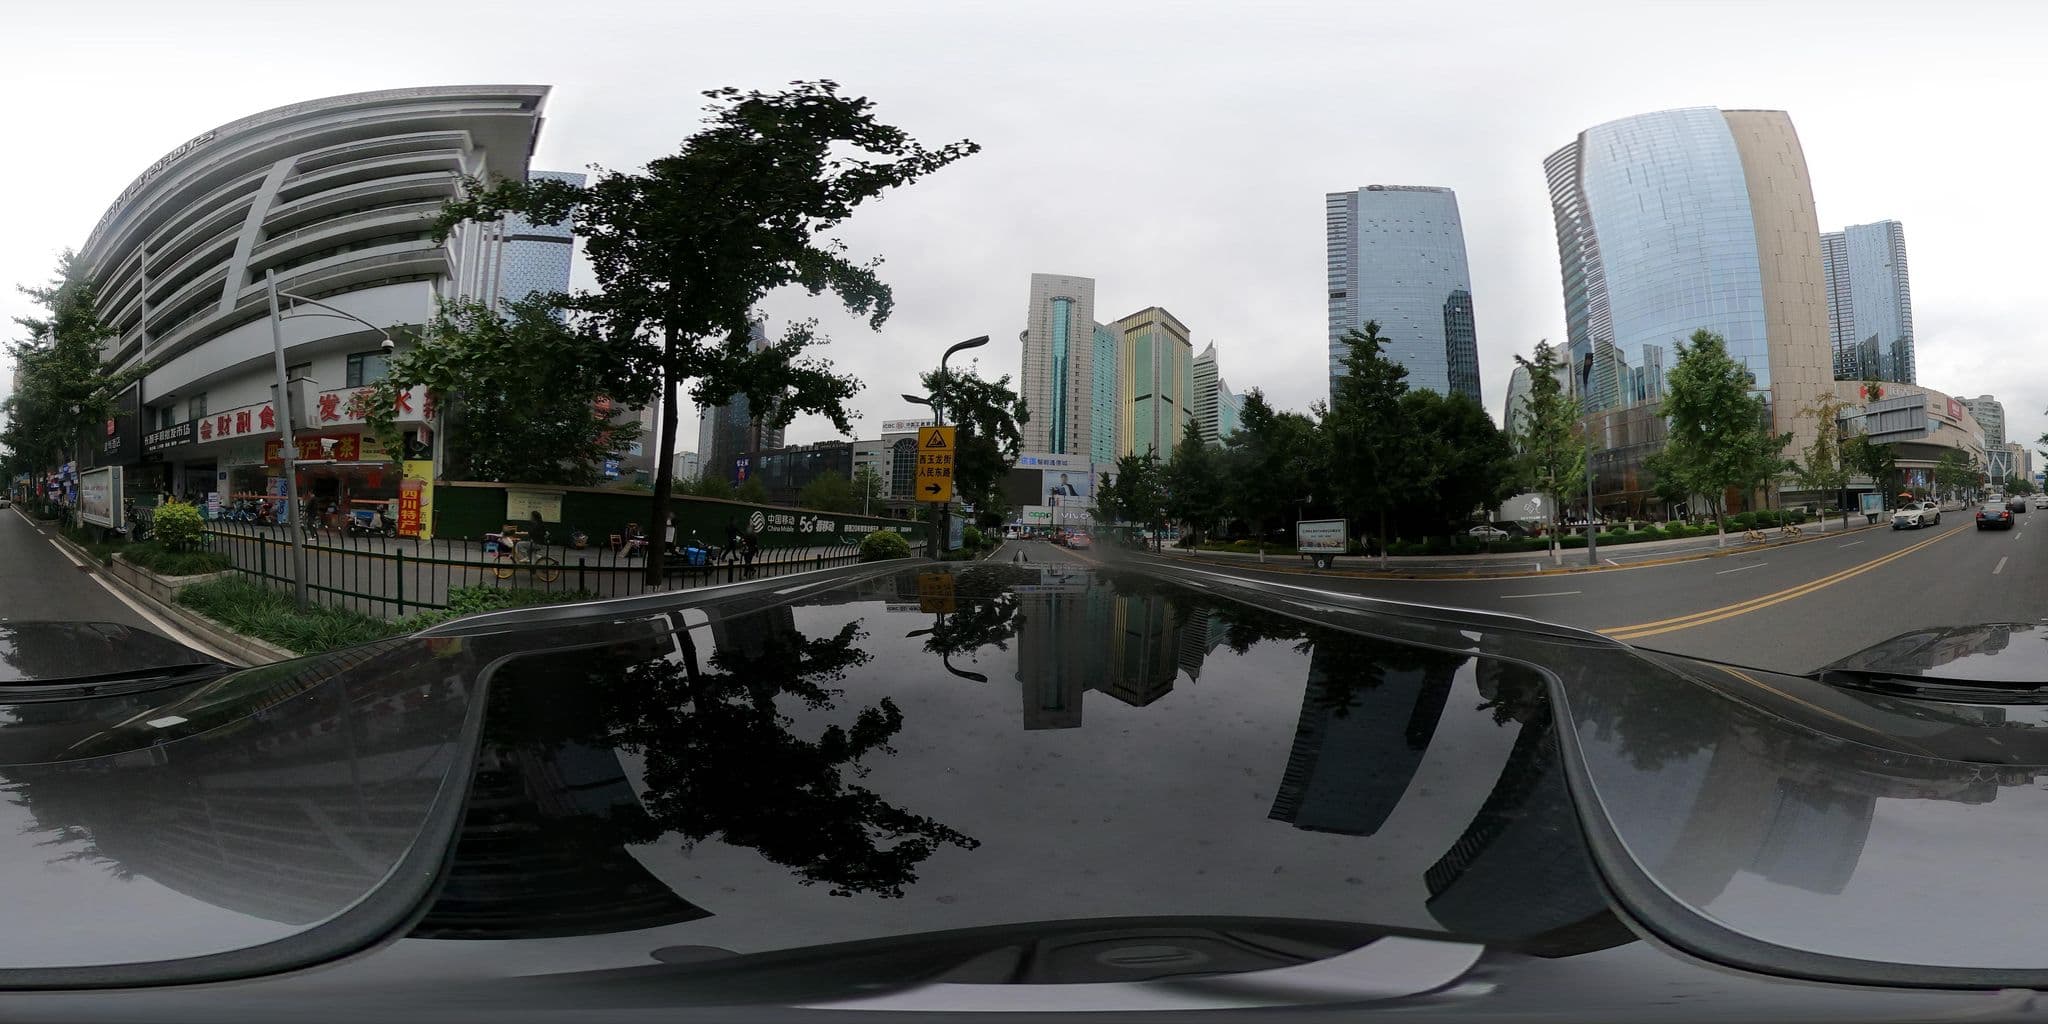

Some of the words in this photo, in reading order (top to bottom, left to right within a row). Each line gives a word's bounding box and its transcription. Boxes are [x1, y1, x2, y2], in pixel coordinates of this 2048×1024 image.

[918, 467, 951, 478] 人民东路
[401, 489, 418, 529] 四川特产
[767, 513, 796, 525] 中国移动
